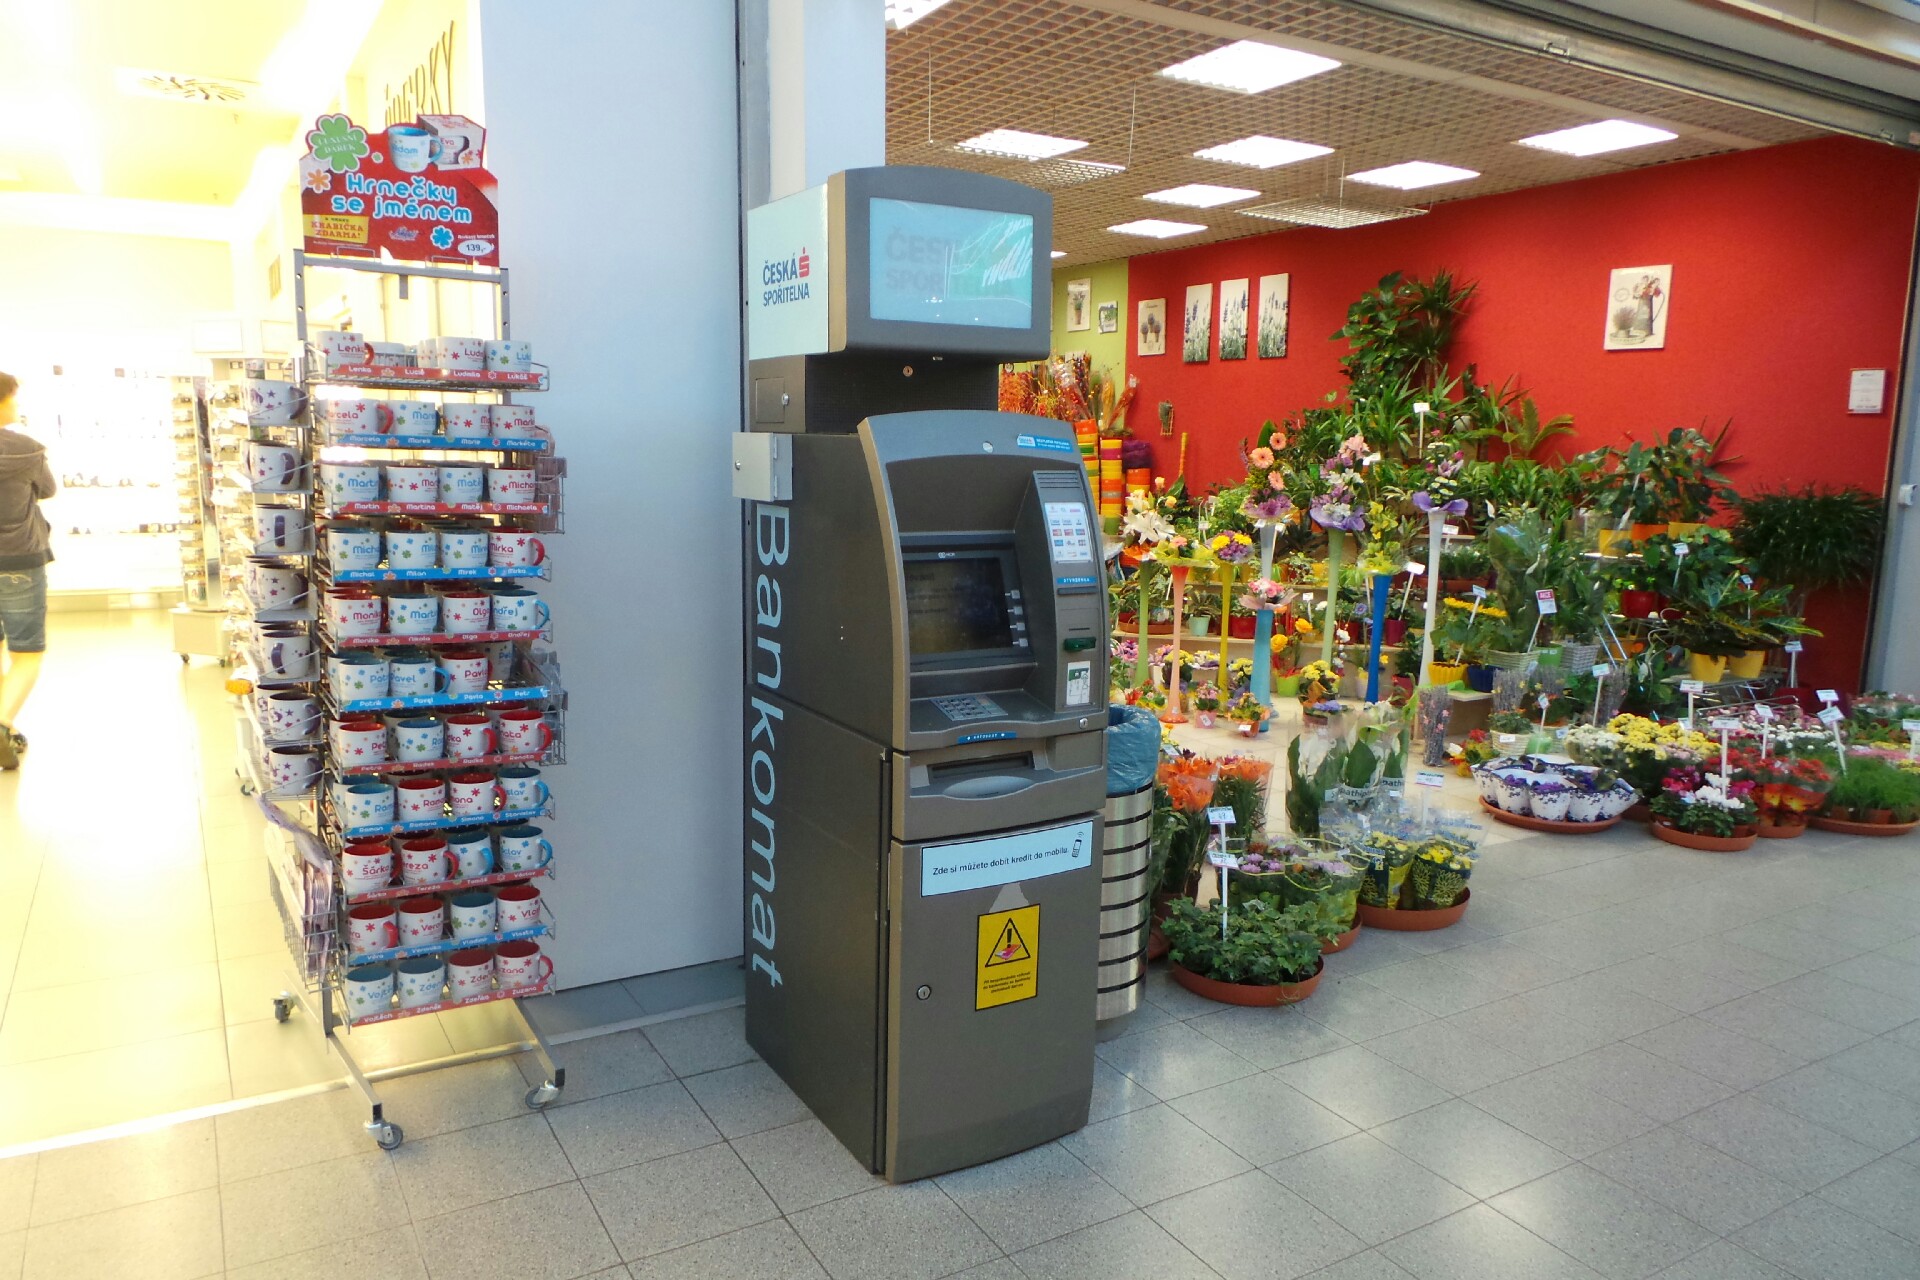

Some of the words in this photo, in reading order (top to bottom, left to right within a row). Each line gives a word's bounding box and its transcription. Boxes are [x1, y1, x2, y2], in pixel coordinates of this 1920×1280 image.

[347, 174, 456, 204] Hrnečky
[332, 196, 364, 212] se
[373, 199, 472, 222] jménem
[763, 252, 798, 286] ČESKÁ
[763, 283, 810, 307] SPOŘITELNA
[750, 506, 790, 988] Bankomat
[932, 867, 949, 875] Zde
[959, 862, 989, 871] můžete
[1011, 854, 1032, 864] kredit
